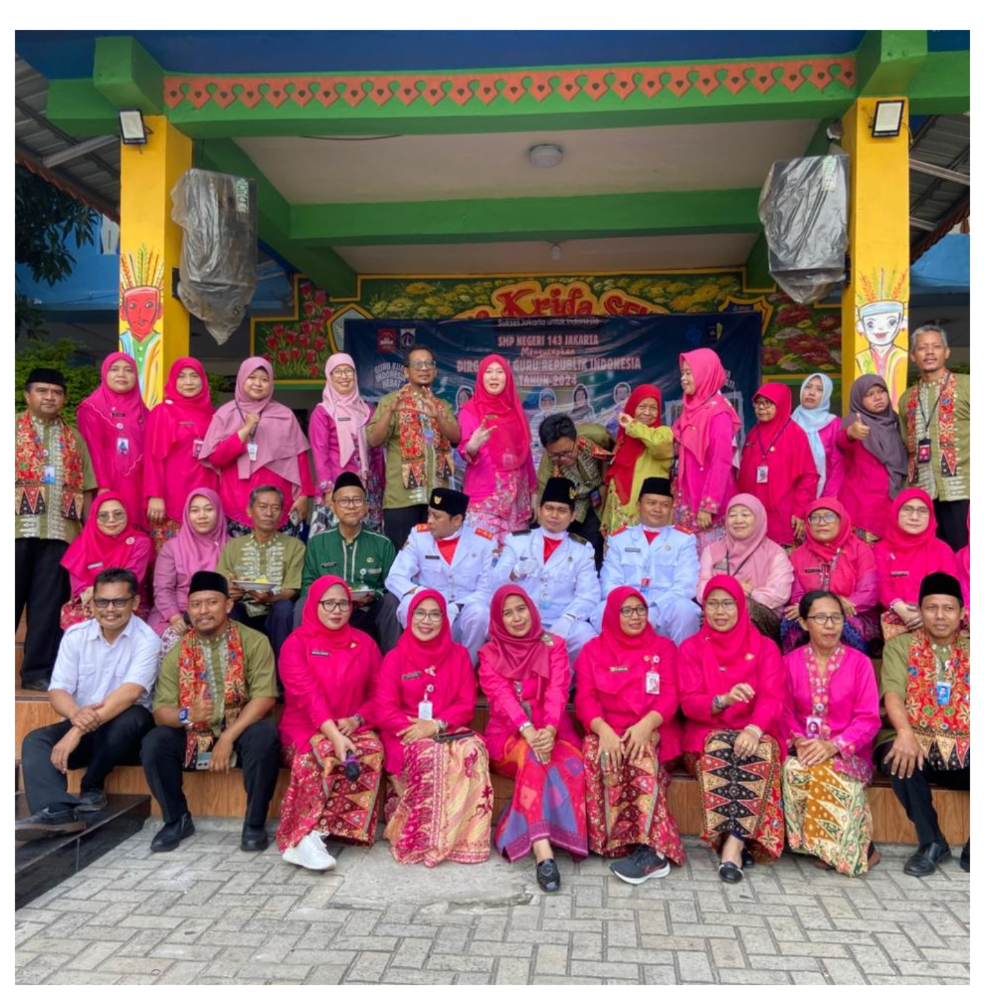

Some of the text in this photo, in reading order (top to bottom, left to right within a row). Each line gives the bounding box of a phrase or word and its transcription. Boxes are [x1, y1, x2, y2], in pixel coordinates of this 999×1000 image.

[496, 286, 593, 317] Krida
[498, 334, 599, 347] SMP NEGERI 143 JAKARTA
[374, 362, 391, 375] GURU
[513, 359, 538, 371] GURU
[543, 358, 588, 371] REPUBLIK
[590, 357, 641, 370] INDONESIA
[519, 374, 578, 386] TAHUN 2024
